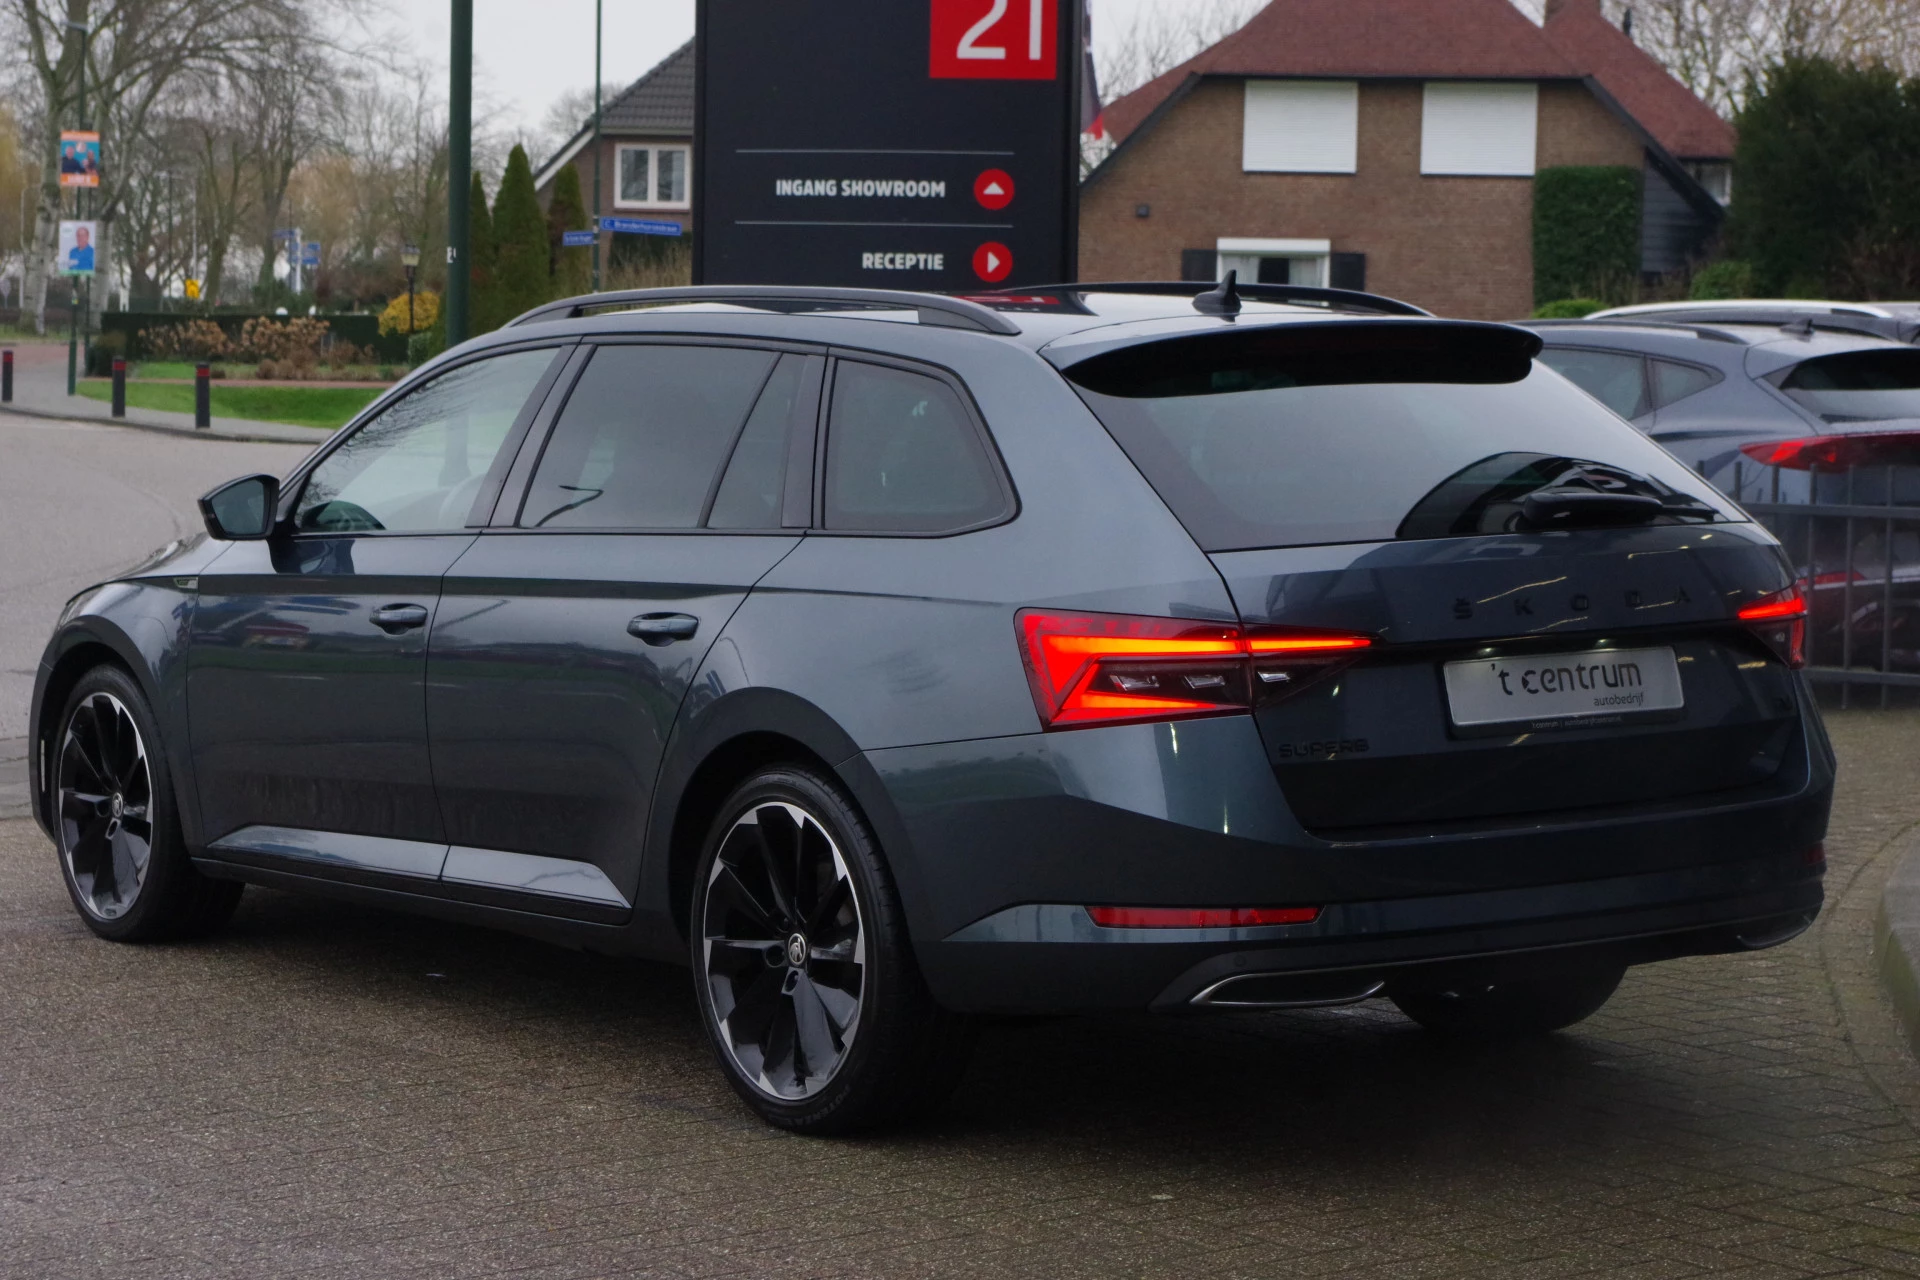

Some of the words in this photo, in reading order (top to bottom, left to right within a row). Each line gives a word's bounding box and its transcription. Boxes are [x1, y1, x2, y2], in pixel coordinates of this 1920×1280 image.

[956, 0, 1042, 60] 21
[776, 179, 837, 197] INGANG
[841, 180, 946, 198] SHOWROOM
[862, 252, 944, 270] RECEPTIE
[1521, 662, 1642, 695] centrum
[1593, 692, 1645, 707] autobedrijf
[1279, 739, 1369, 758] SUPERB
